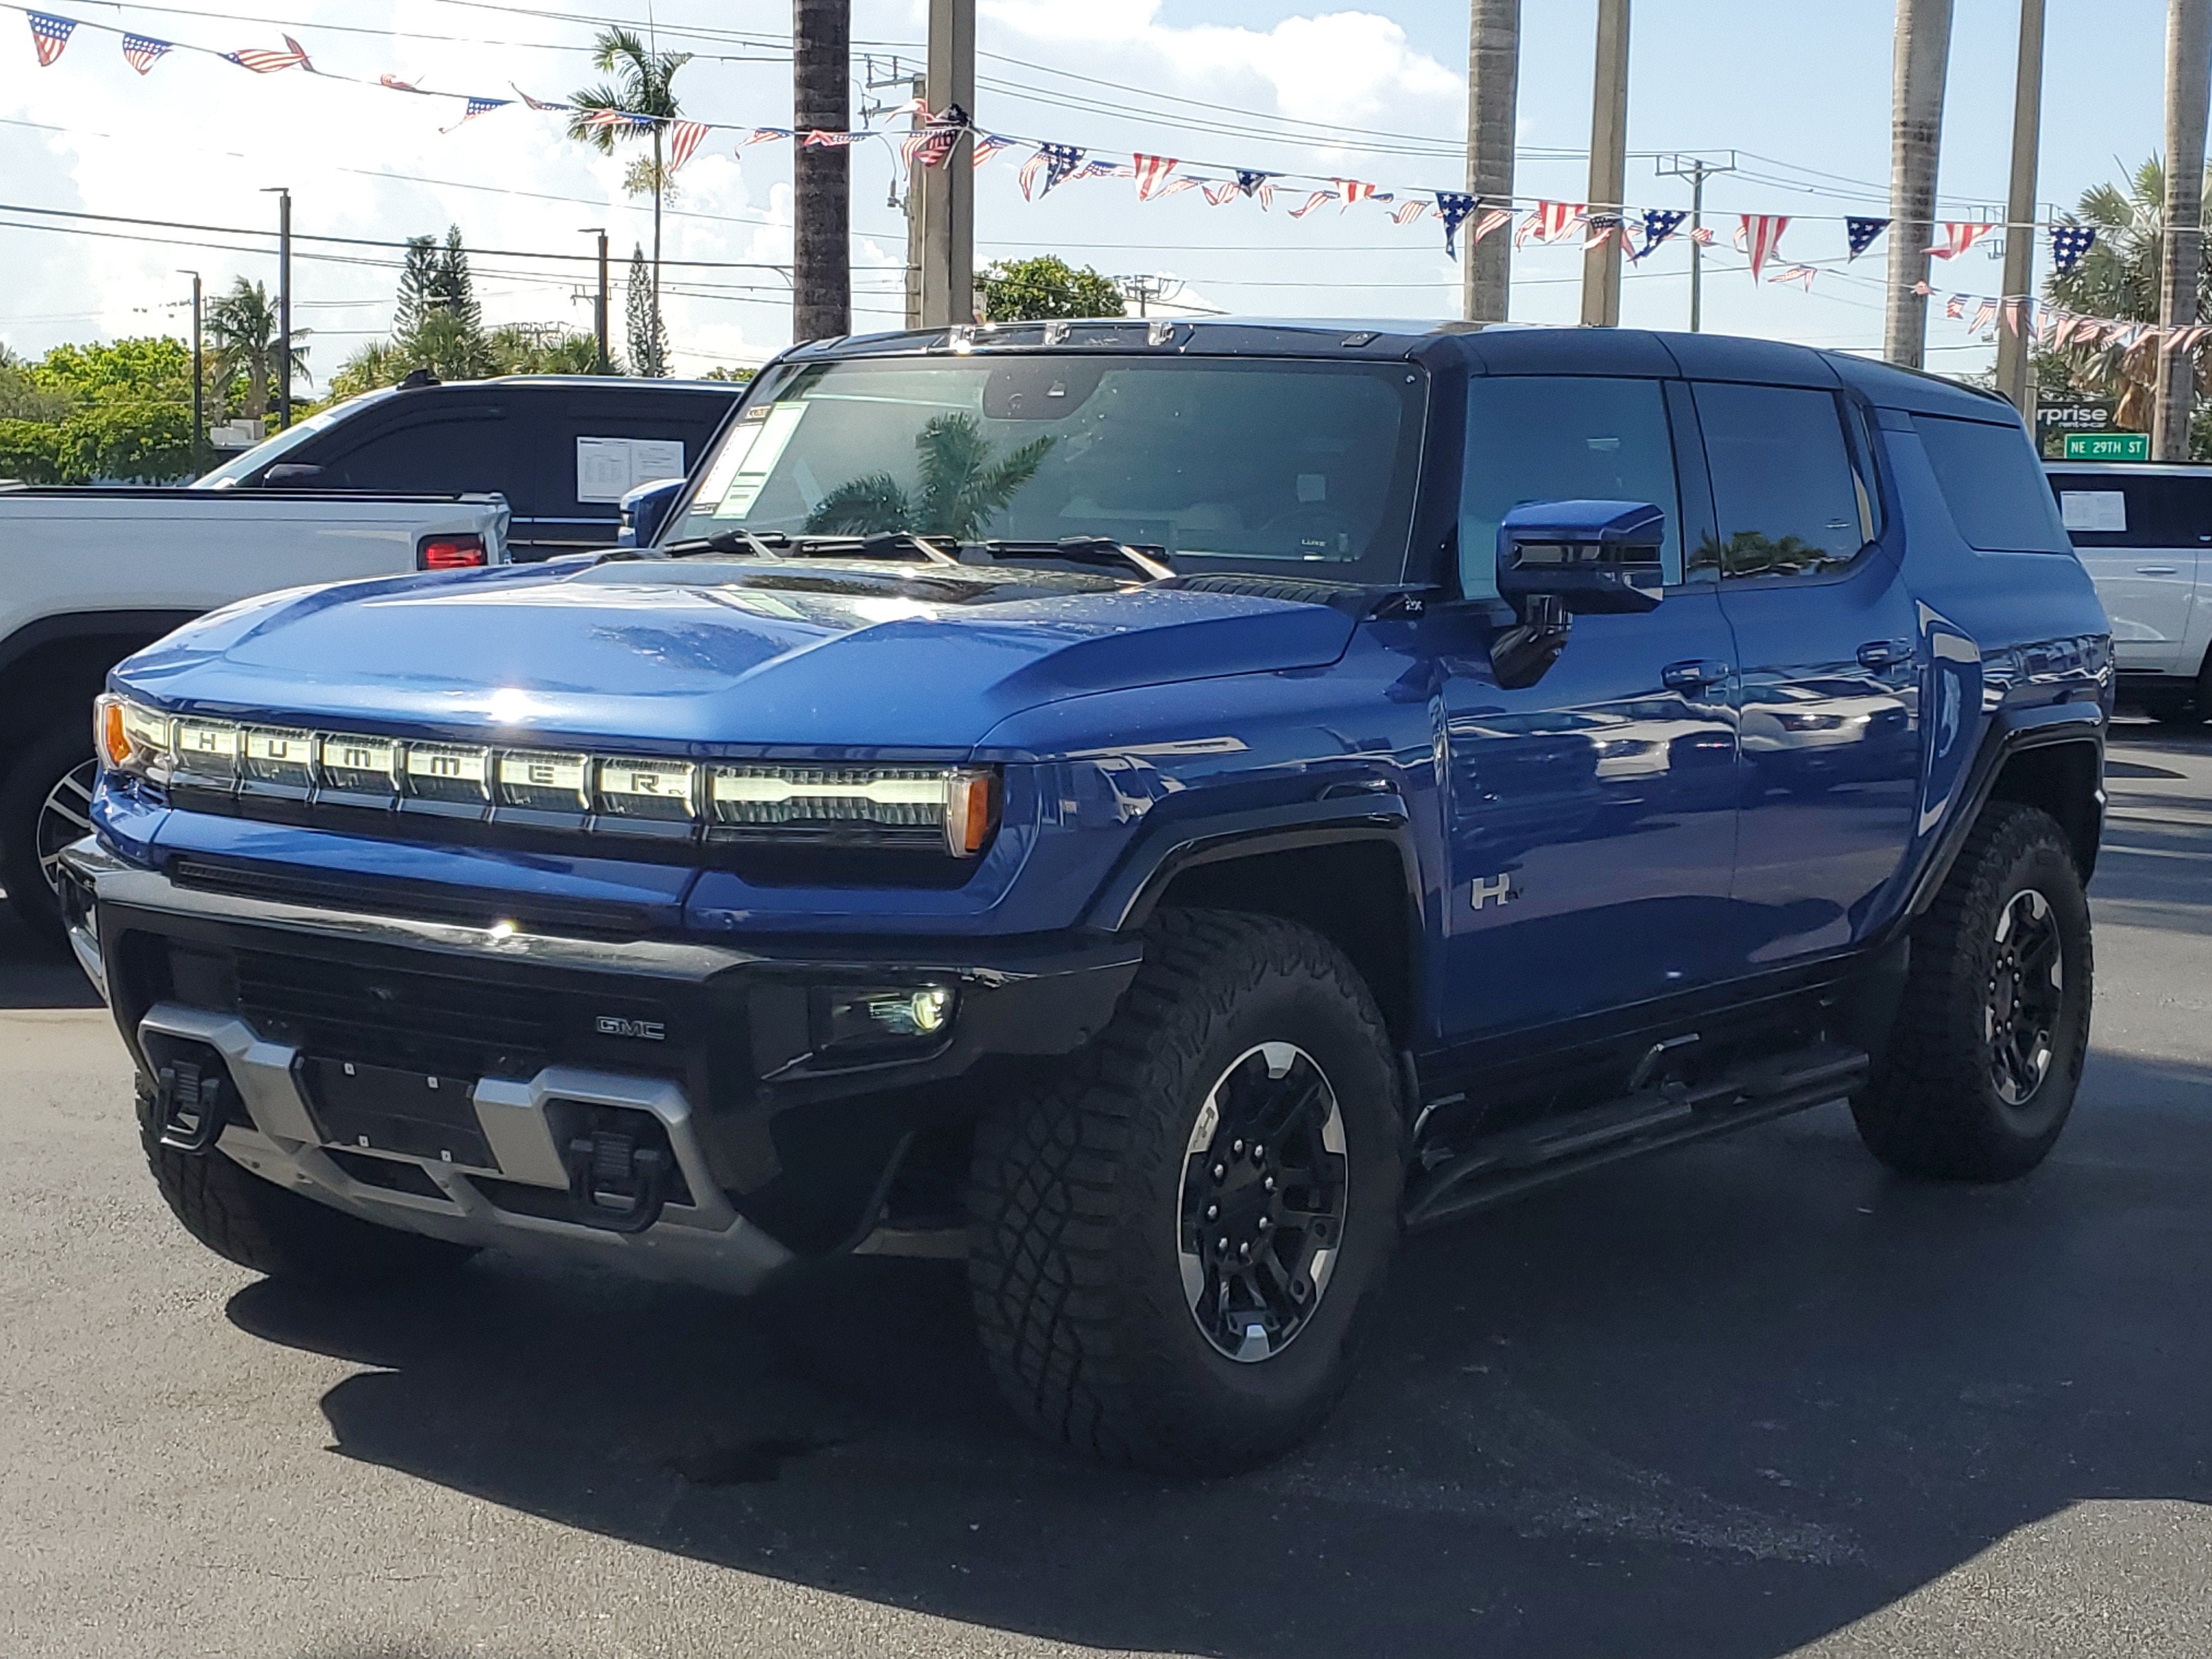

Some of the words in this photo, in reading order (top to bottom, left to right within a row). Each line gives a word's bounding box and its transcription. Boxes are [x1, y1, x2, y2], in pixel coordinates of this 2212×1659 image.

[2037, 404, 2108, 425] rprise
[2070, 441, 2086, 454] NE
[2092, 441, 2121, 454] 29TH
[2128, 441, 2143, 454] ST
[199, 732, 659, 793] HUMMER
[596, 1015, 665, 1040] GMC
